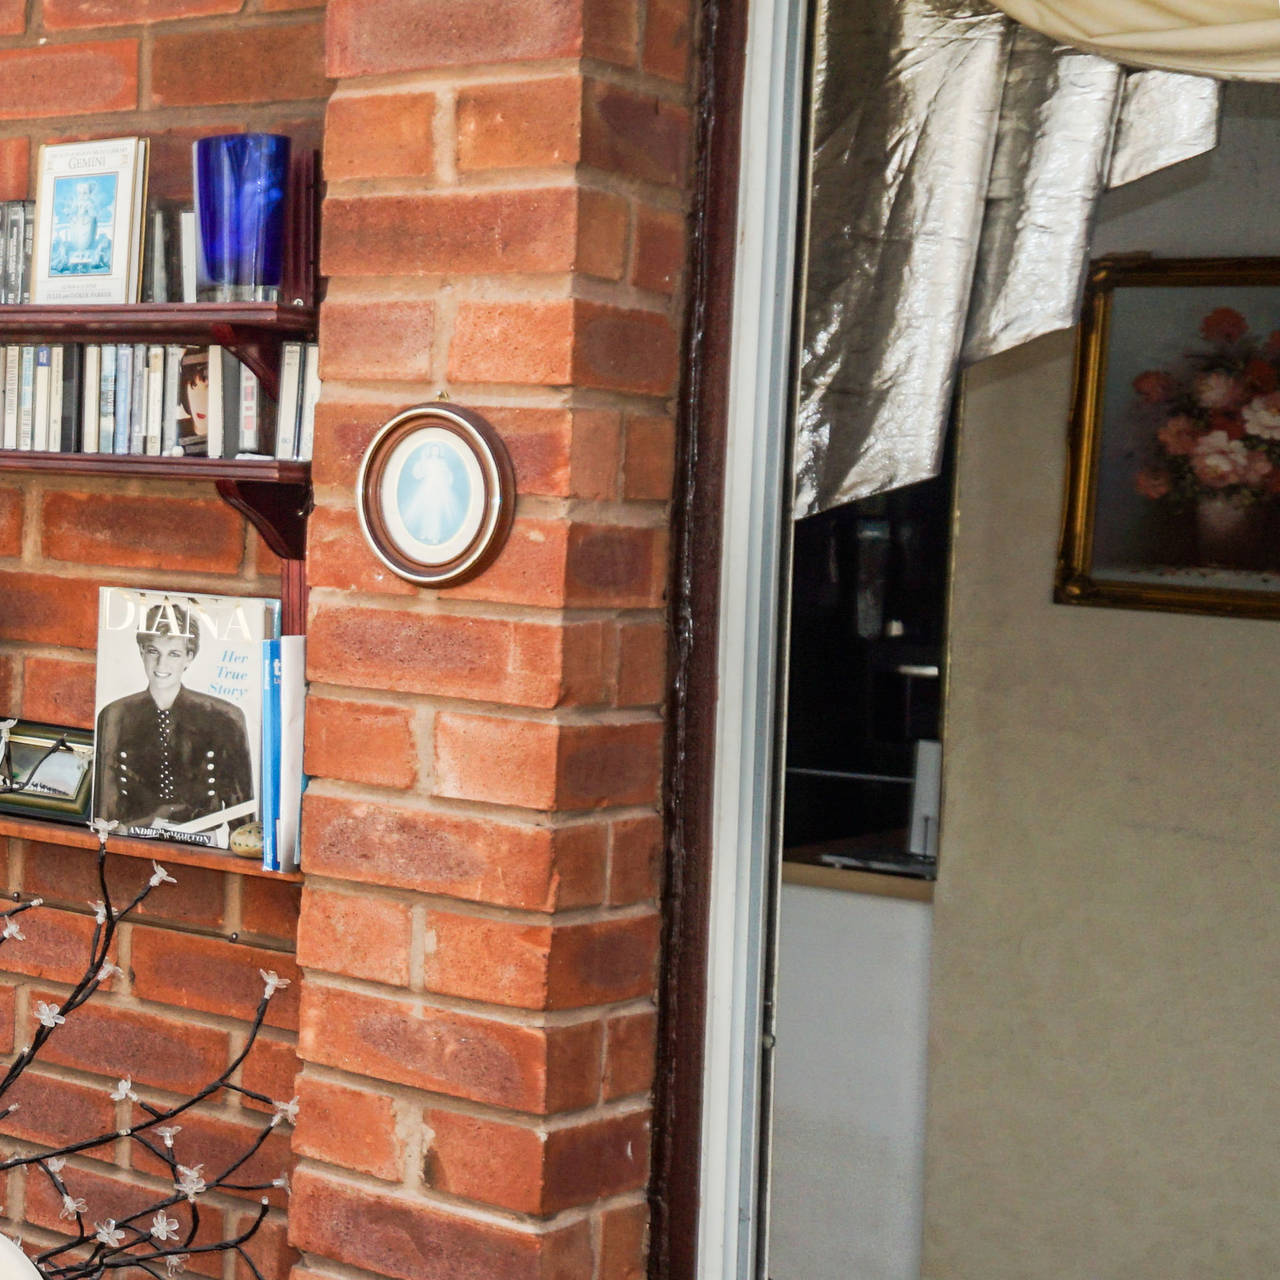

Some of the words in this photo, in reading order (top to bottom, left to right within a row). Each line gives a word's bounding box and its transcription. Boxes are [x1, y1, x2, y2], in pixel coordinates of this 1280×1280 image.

[68, 156, 106, 170] GEMINI
[103, 587, 254, 643] DIANA
[221, 650, 249, 664] Her
[216, 665, 248, 681] True
[208, 683, 249, 701] Story
